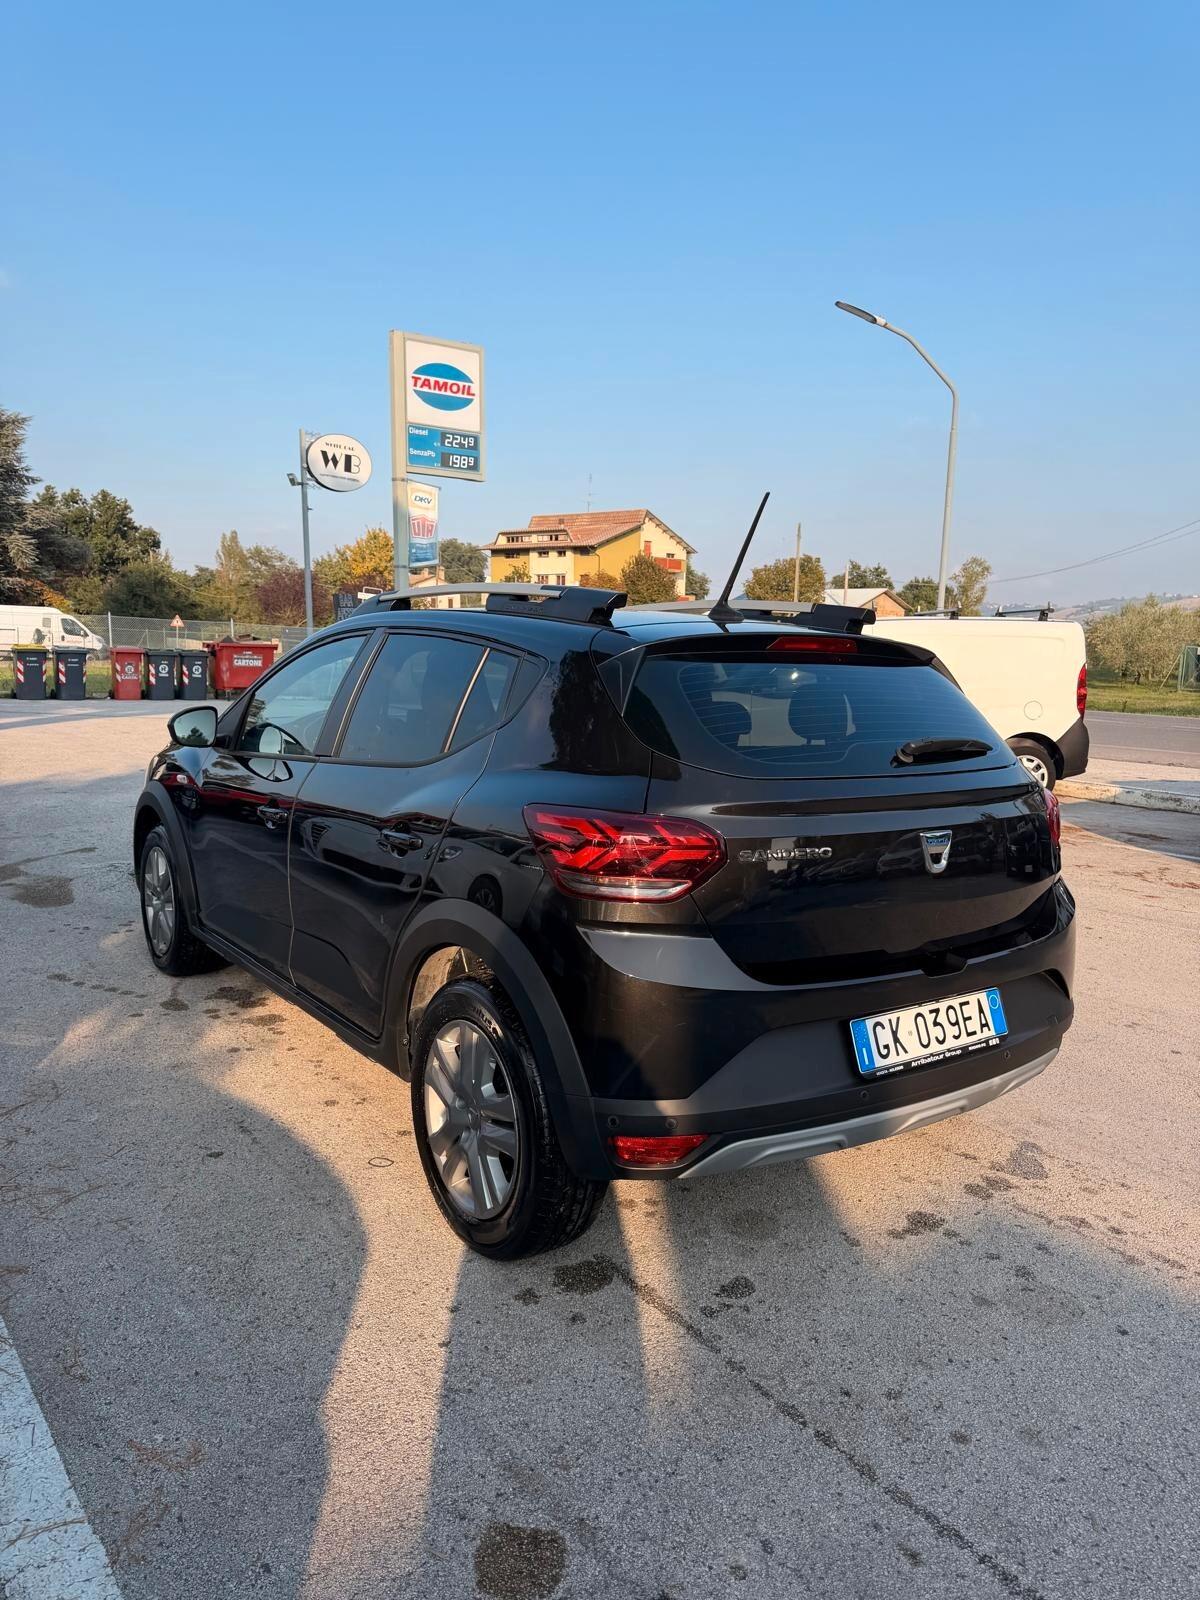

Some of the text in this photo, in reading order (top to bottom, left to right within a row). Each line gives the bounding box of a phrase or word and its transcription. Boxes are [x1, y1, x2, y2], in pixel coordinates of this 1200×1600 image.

[411, 375, 476, 397] TAMOIL
[409, 426, 428, 436] Diesel
[444, 434, 474, 449] 2249
[449, 455, 474, 469] 1989
[414, 495, 433, 505] DKV
[233, 658, 262, 667] CARTONE
[739, 847, 832, 862] SANDERO
[872, 1016, 909, 1060] GK
[914, 998, 991, 1050] 039EA
[945, 1048, 962, 1058] Group
